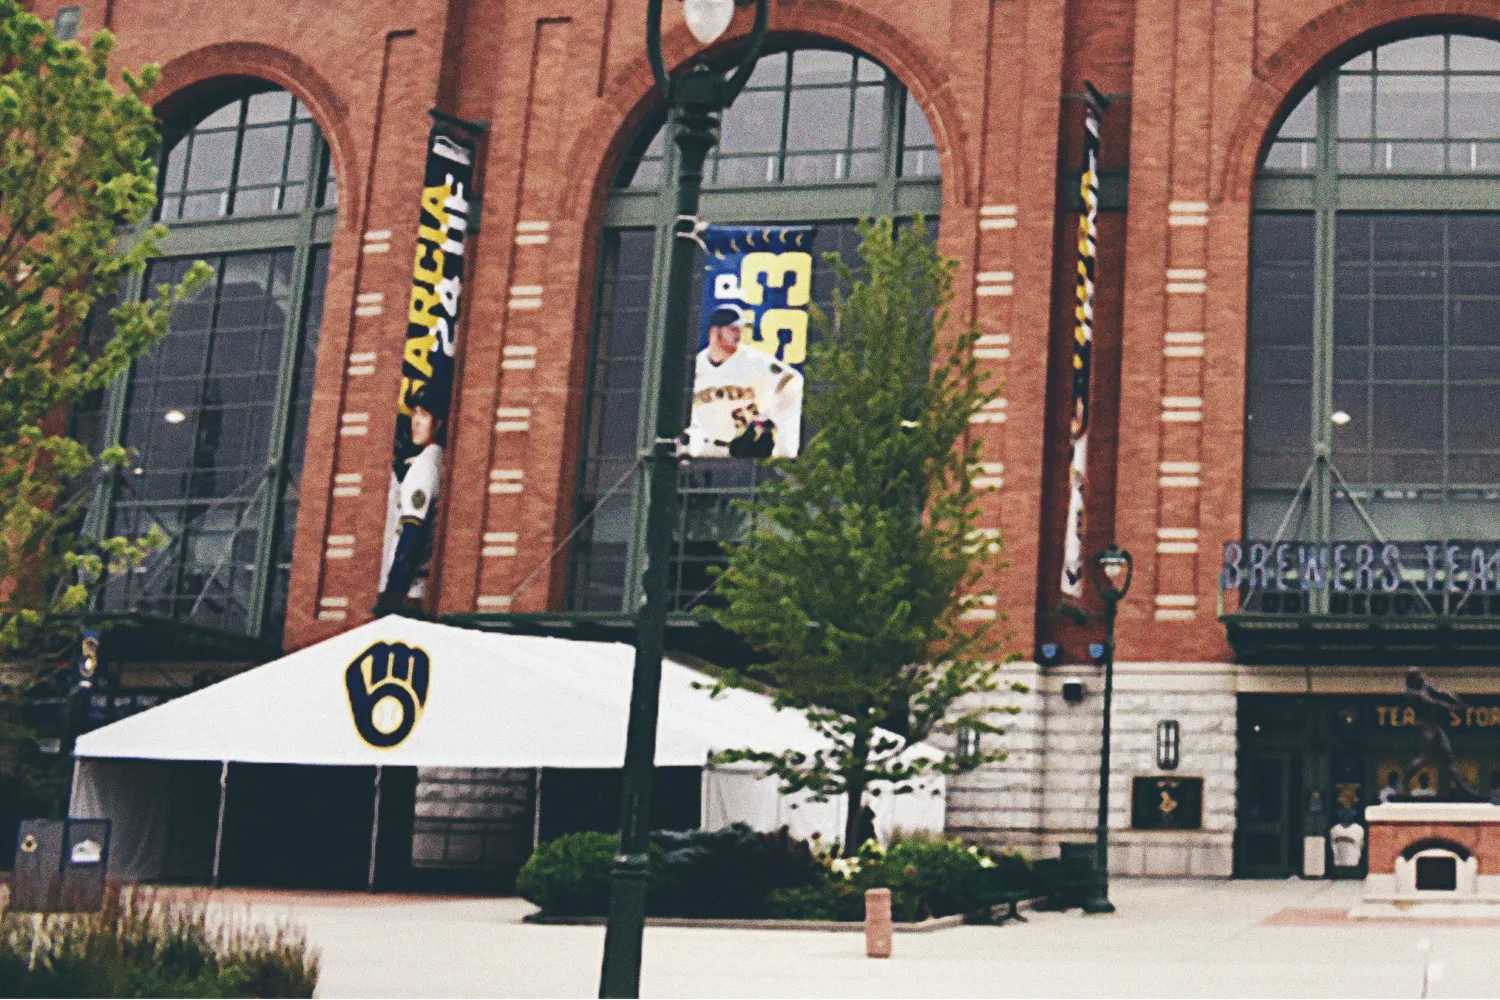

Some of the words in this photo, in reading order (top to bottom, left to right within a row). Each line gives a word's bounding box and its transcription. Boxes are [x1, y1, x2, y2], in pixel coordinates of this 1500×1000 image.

[398, 183, 452, 415] GARCIA
[740, 251, 813, 364] 53
[1225, 543, 1401, 592] BREWERS
[1376, 705, 1432, 728] TEA
